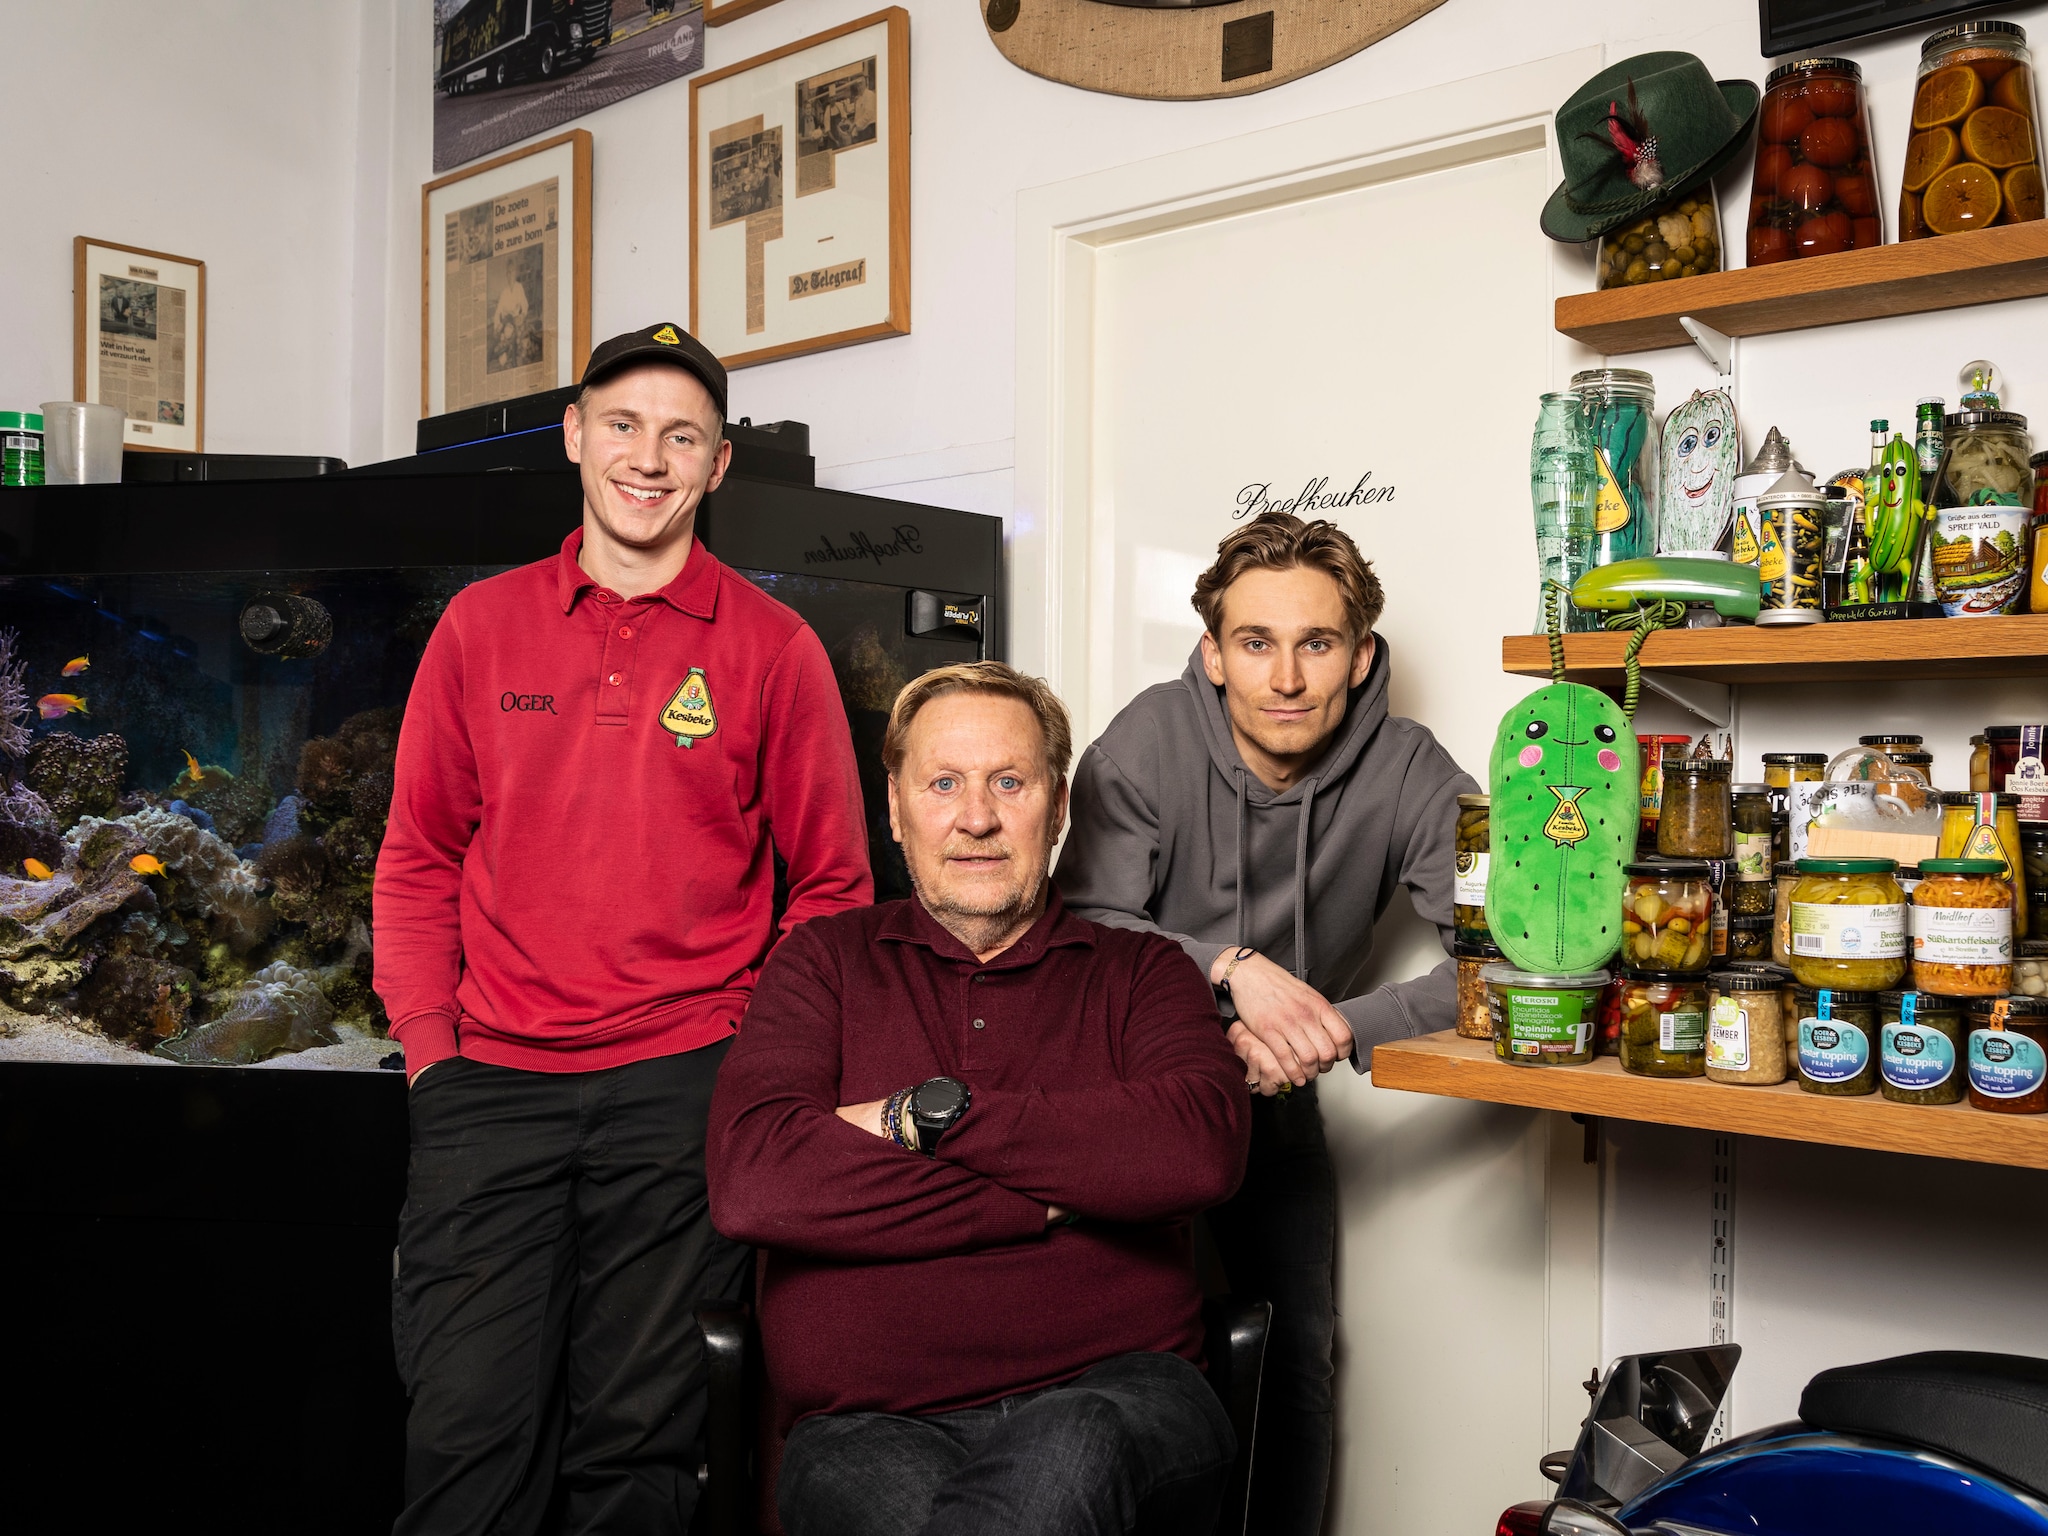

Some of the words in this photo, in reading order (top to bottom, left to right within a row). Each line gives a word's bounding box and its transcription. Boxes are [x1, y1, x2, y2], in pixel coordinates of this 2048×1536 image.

[647, 30, 695, 58] TRUCKLAND
[495, 205, 506, 217] De
[508, 198, 529, 213] zoete
[494, 216, 519, 234] smaak
[521, 213, 536, 225] van
[494, 239, 504, 251] de
[506, 235, 523, 248] zure
[524, 228, 543, 241] bom
[792, 276, 809, 295] De
[810, 260, 864, 290] Telegraaf
[100, 341, 115, 350] Wat
[123, 345, 134, 353] het
[135, 347, 146, 355] vat
[109, 351, 137, 361] verzuurt
[138, 355, 151, 363] niet
[1232, 471, 1395, 520] Proefkeuken
[1947, 514, 1966, 522] Grüße
[1760, 556, 1783, 568] esbeke
[943, 610, 970, 620] FLIPPER
[500, 691, 558, 715] OGER
[667, 709, 712, 726] Kesbeke
[2026, 726, 2037, 750] Jonnie
[2010, 779, 2029, 787] Jonnie
[2011, 785, 2024, 793] Oos
[2024, 785, 2048, 793] Kesbeke
[1552, 824, 1581, 832] Kesbeke
[1870, 906, 1900, 919] Maidlhof
[1932, 911, 1975, 926] Maidlhof
[1927, 933, 2000, 945] Süßkartoffelsalat
[1512, 1006, 1550, 1014] Encurtidos
[1513, 1017, 1554, 1025] Envinagrats
[1513, 1023, 1561, 1034] Pepinillos
[1713, 1028, 1739, 1040] GEMBER
[1524, 1032, 1553, 1040] vinagre
[1822, 1051, 1858, 1064] topping
[1811, 1060, 1834, 1068] FRANS
[1906, 1057, 1943, 1071] topping
[1895, 1066, 1918, 1075] FRANS
[1993, 1065, 2033, 1080] topping
[1981, 1074, 2013, 1085] AZIATISCH
